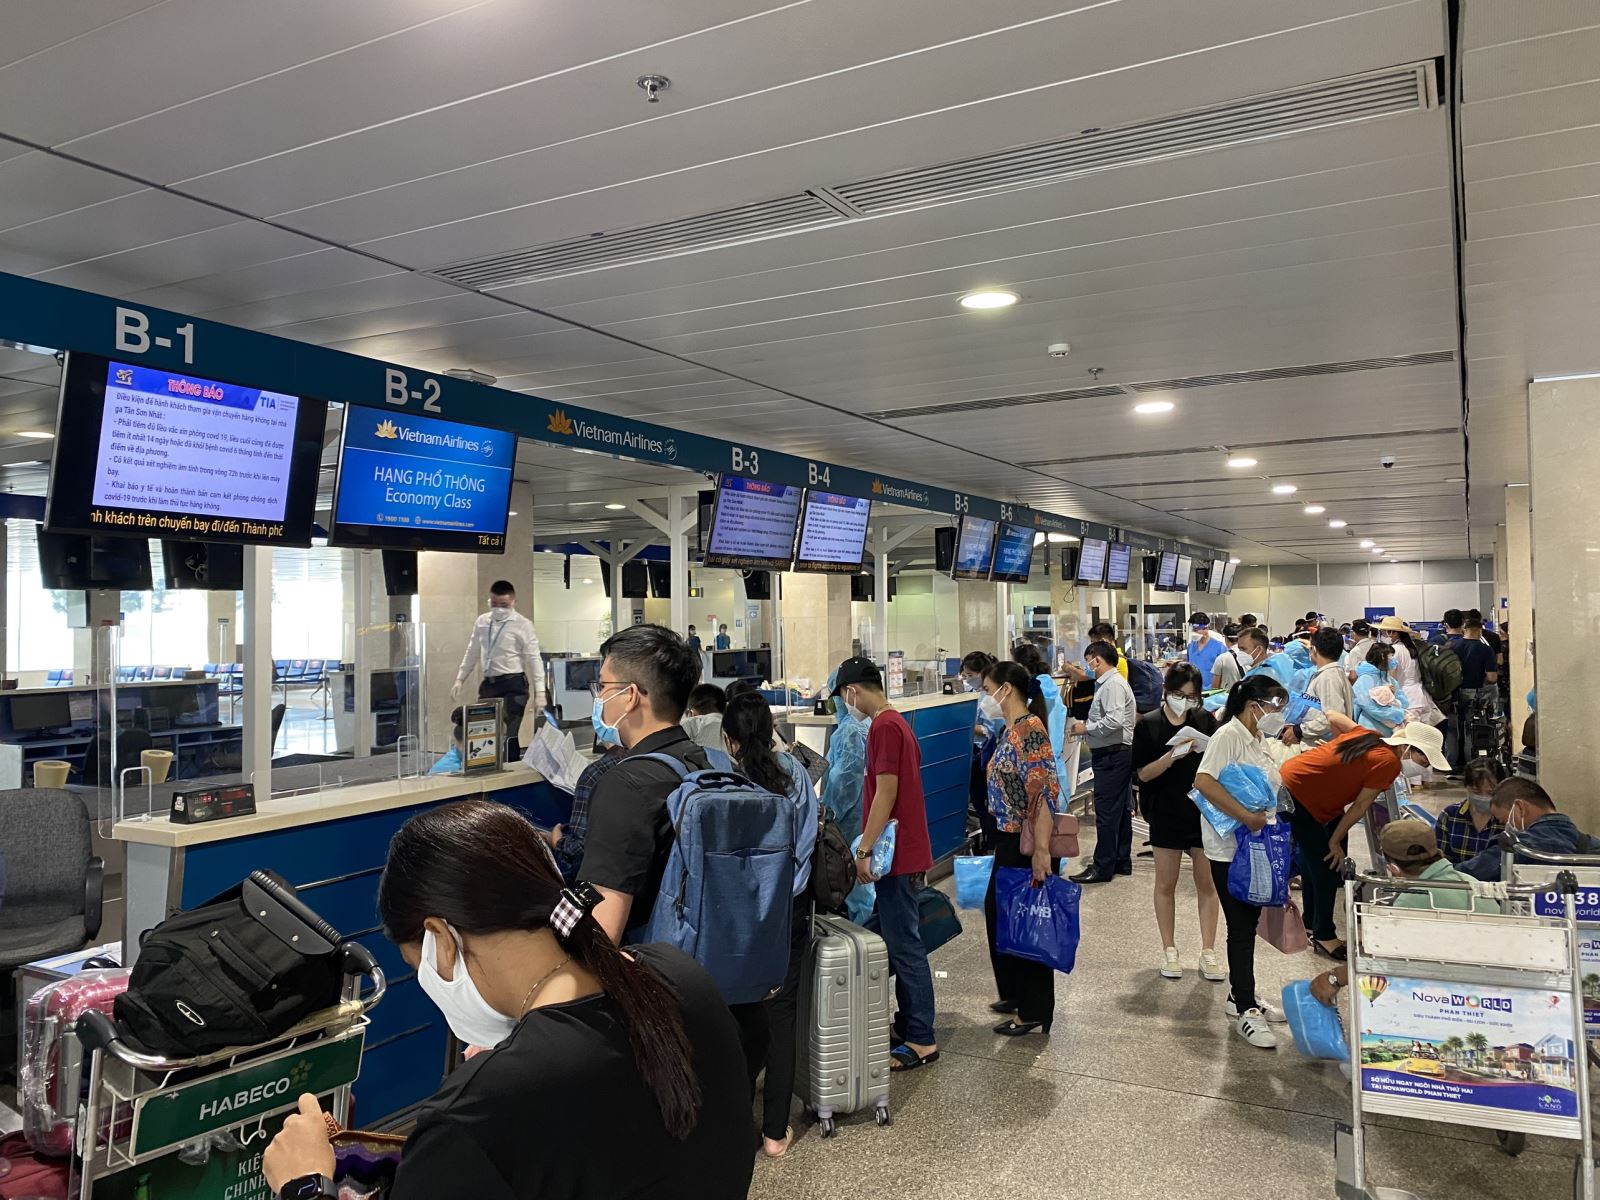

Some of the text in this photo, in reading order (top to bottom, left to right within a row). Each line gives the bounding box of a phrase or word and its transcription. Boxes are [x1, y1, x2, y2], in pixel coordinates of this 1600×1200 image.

[116, 306, 194, 364] B-1
[168, 378, 224, 400] THÔNG BÁO
[385, 367, 441, 413] B-2
[260, 396, 276, 410] TIA
[106, 467, 120, 477] bay.
[732, 447, 759, 475] B-3
[374, 466, 485, 492] HẠNG PHỔ THÔNG
[808, 462, 831, 488] B-4
[386, 488, 472, 510] Economy Class
[954, 494, 968, 512] B-5
[105, 510, 135, 525] khách
[138, 514, 156, 526] trên
[158, 516, 192, 531] chuyến
[194, 518, 210, 533] bay
[212, 520, 240, 533] đi/đến
[242, 522, 267, 534] Thành
[1001, 504, 1012, 521] B-6
[478, 534, 490, 546] Tất
[1080, 522, 1089, 536] B-7
[1030, 905, 1052, 918] MB
[200, 1078, 290, 1120] HABECO
[1383, 1085, 1422, 1094] NOVAWORLD
[238, 1152, 264, 1176] KIỆ
